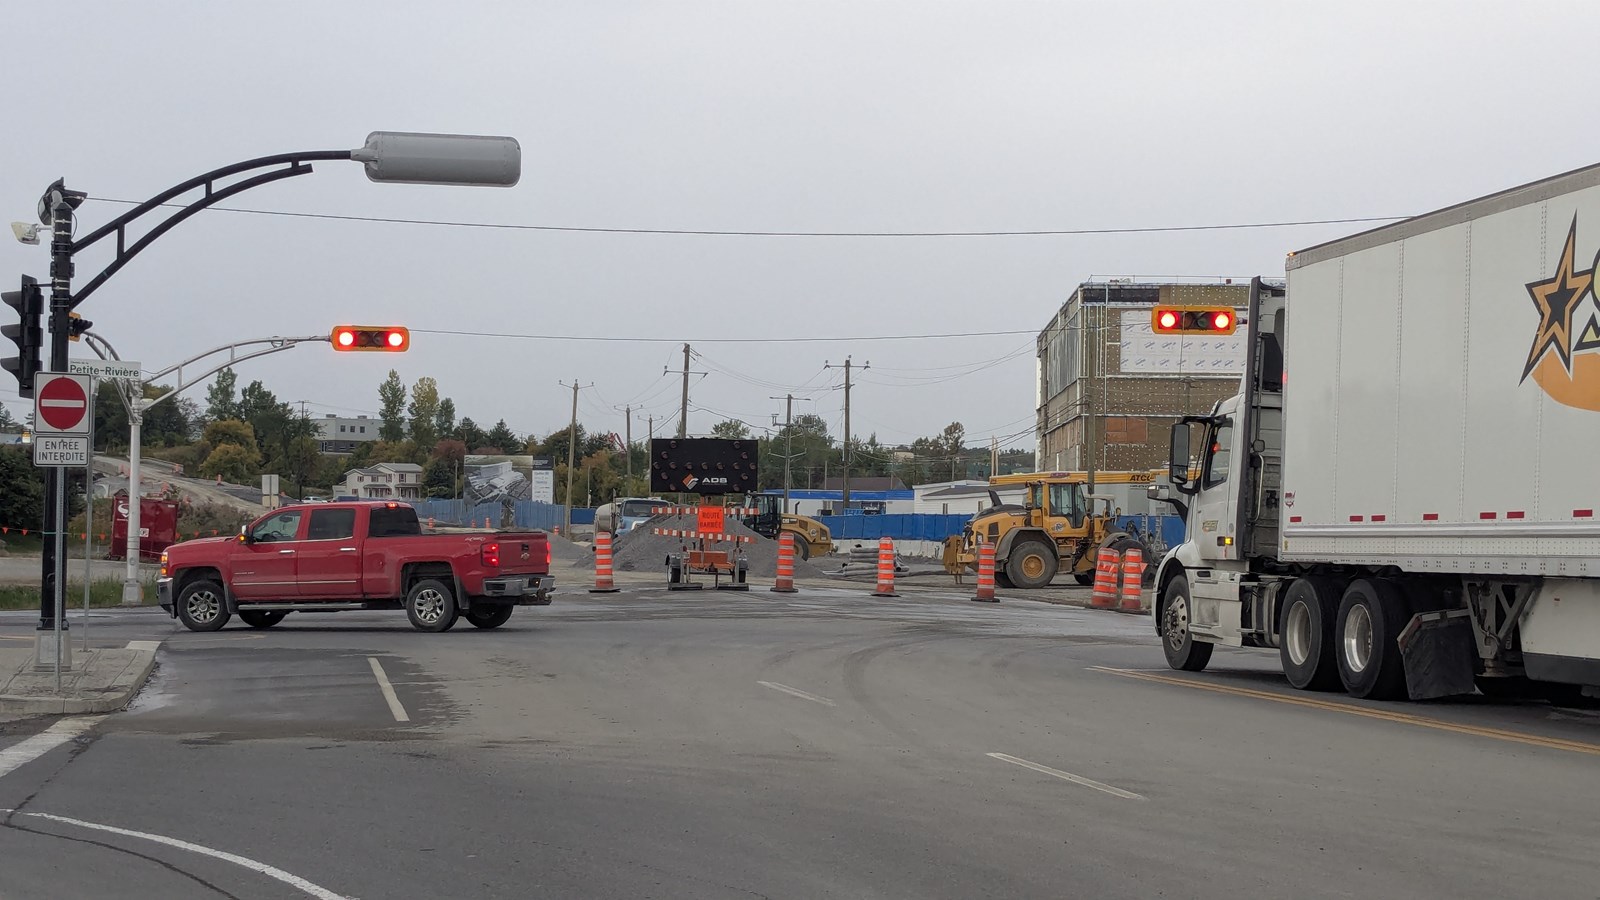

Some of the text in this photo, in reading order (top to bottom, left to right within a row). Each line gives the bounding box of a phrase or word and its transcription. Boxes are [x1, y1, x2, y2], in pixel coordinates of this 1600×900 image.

[70, 364, 139, 377] Petite-Rivière
[45, 439, 79, 450] ENTRÉE
[38, 451, 85, 461] INTERDITE
